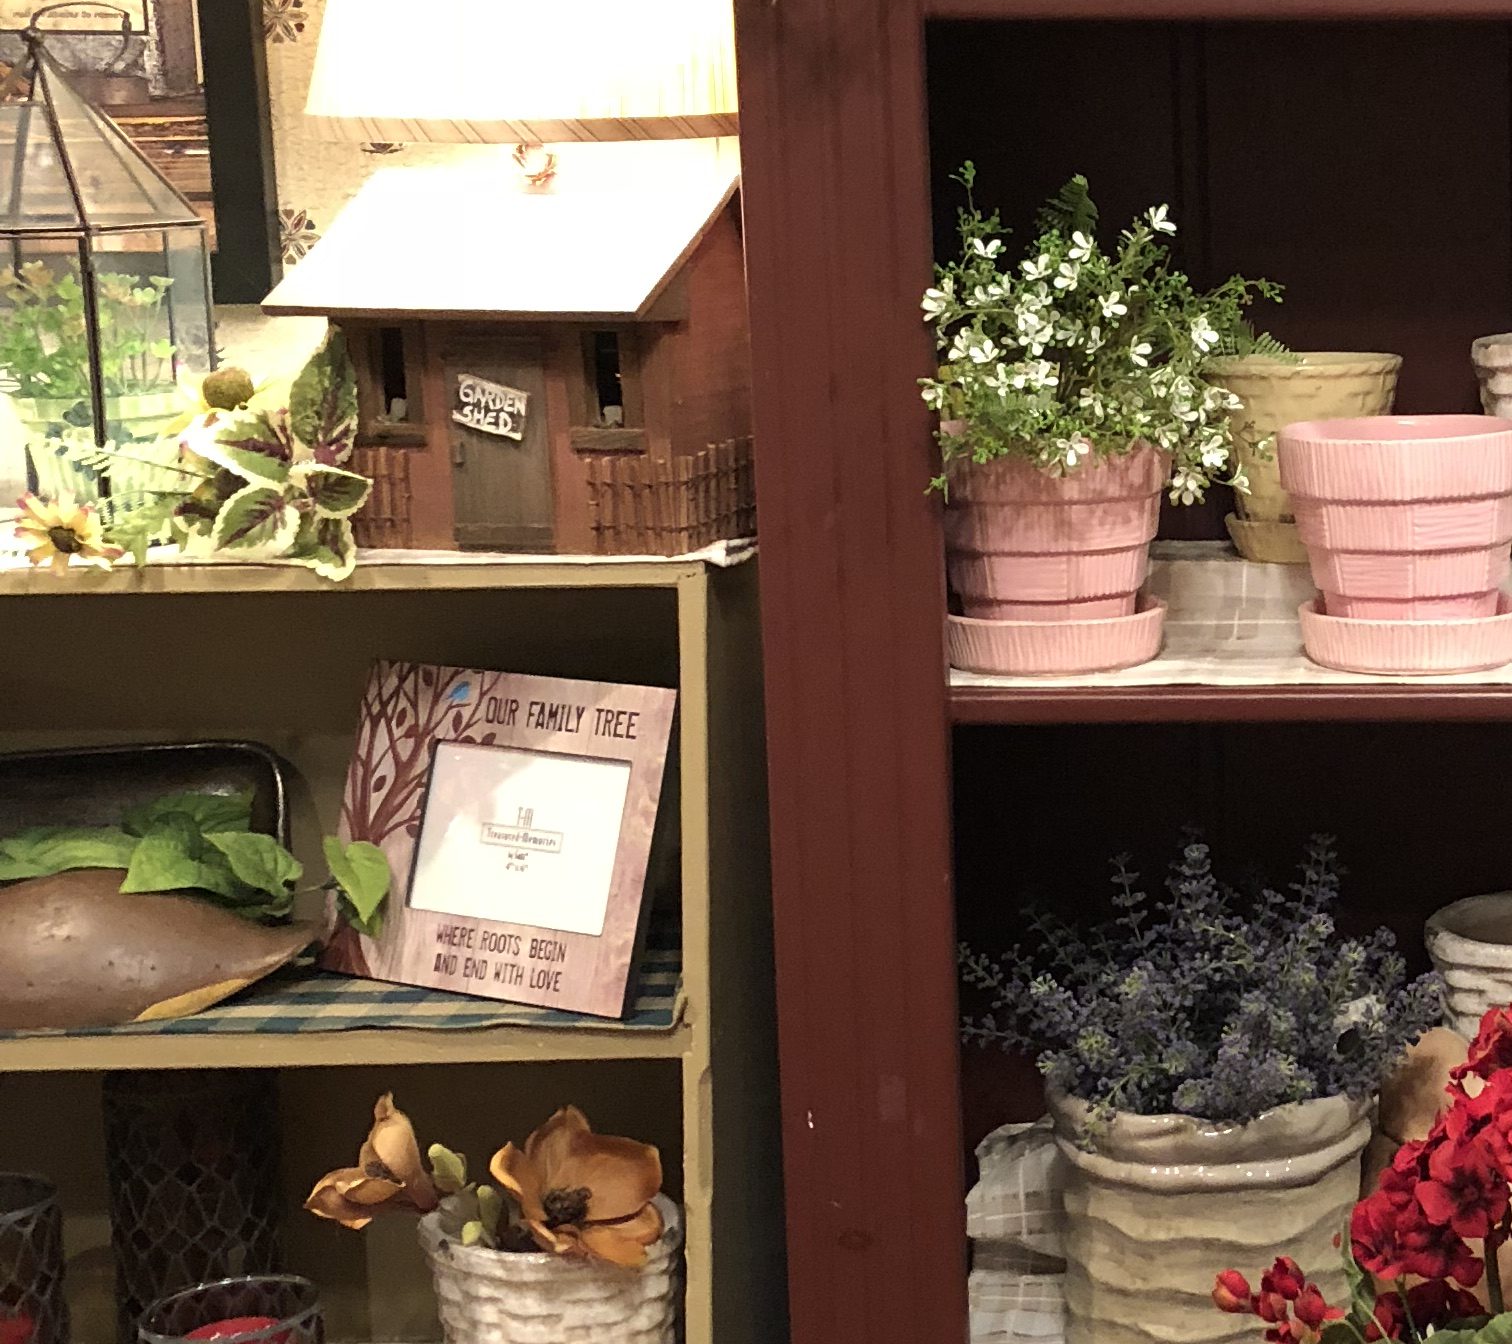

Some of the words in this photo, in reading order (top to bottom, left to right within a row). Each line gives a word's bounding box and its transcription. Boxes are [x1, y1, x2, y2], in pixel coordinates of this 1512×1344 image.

[459, 379, 527, 417] GARDEN
[462, 405, 513, 435] SHED
[485, 696, 520, 728] OUR
[526, 701, 586, 734] FAMILY
[594, 708, 640, 740] TREE
[436, 923, 476, 949] WHERE
[480, 930, 523, 956] ROOTS
[528, 938, 567, 963] BEGIN
[433, 952, 458, 976] AND
[463, 957, 488, 980] END
[493, 961, 525, 986] WITH
[529, 967, 563, 992] LOVE
